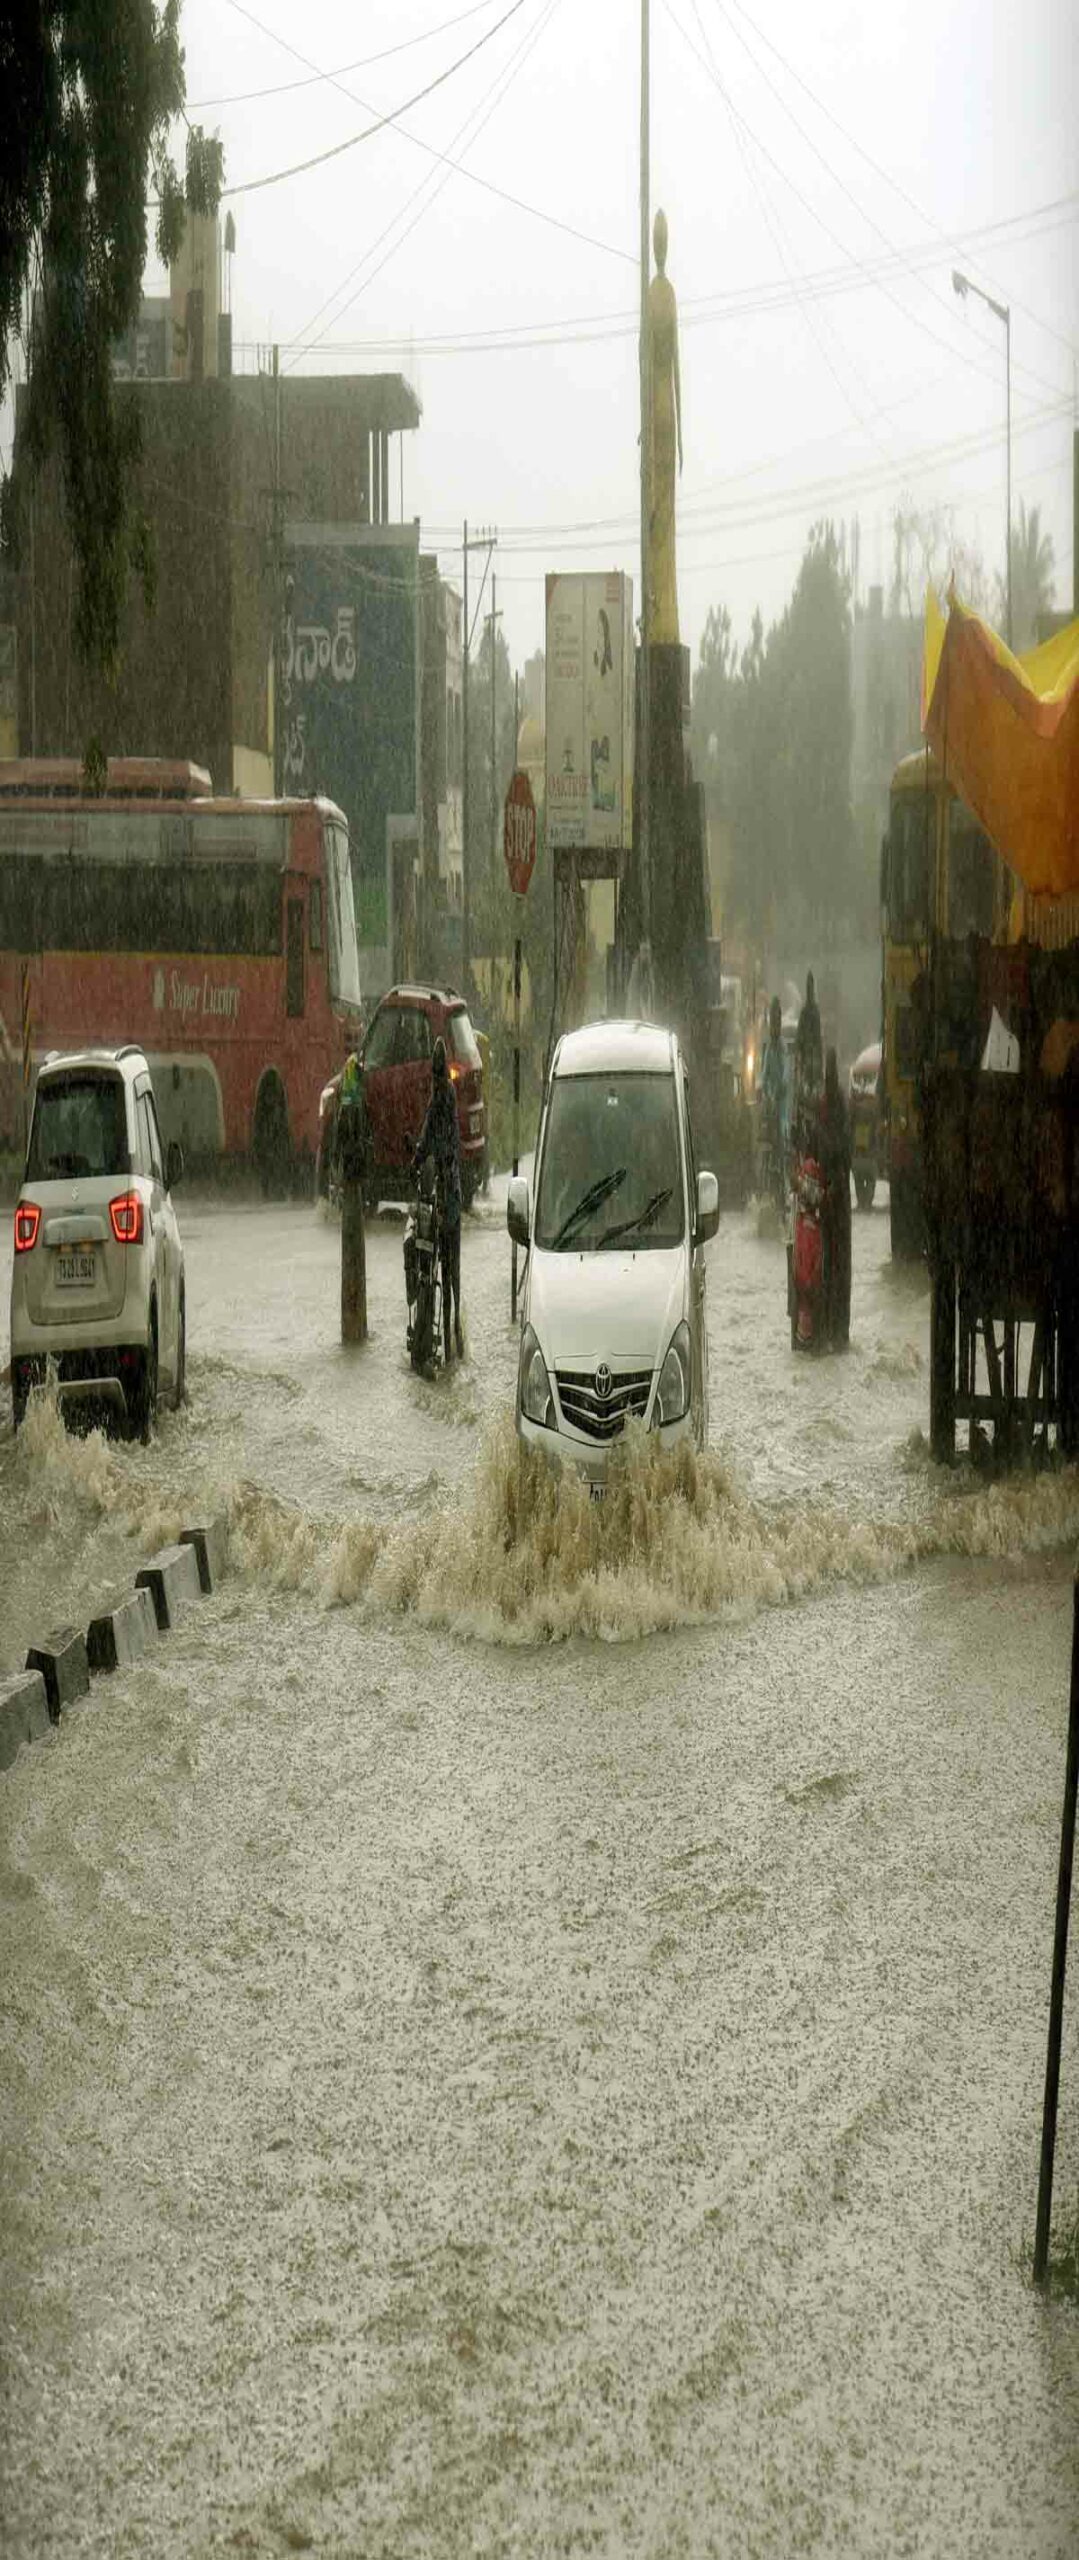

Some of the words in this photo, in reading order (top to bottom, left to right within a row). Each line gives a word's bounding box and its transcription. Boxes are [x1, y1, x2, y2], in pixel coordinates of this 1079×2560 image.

[508, 804, 535, 864] STOP
[170, 970, 200, 1022] Super
[202, 974, 241, 1028] Luxury
